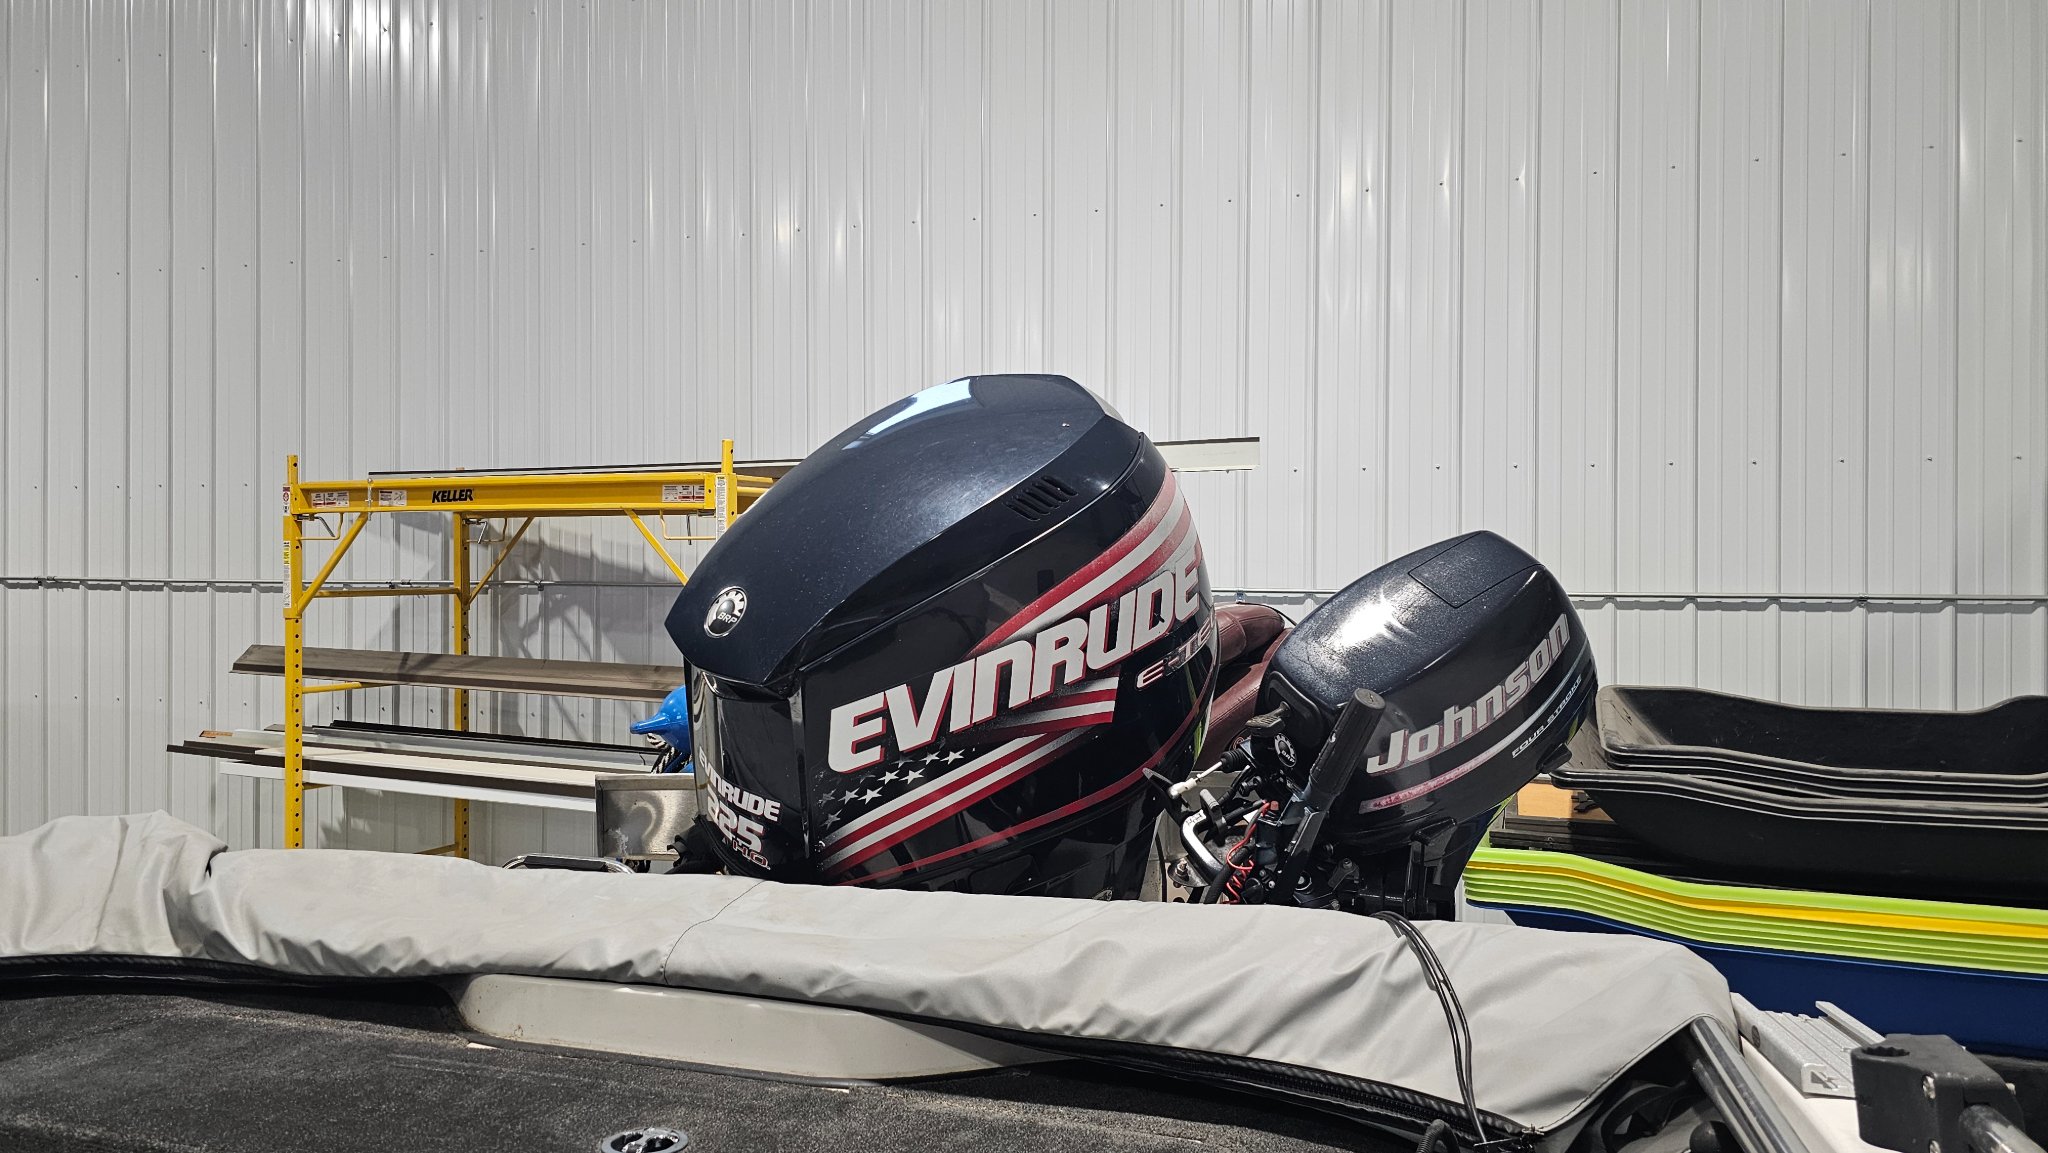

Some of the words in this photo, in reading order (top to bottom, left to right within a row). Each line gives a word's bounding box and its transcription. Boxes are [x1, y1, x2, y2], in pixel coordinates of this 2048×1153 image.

[432, 488, 474, 503] KELLER
[717, 611, 738, 624] BRP
[827, 548, 1200, 773] EVINRUDE
[1366, 613, 1571, 776] Johnson
[1511, 725, 1545, 758] FOUR
[699, 746, 781, 822] EVINRUDE
[707, 783, 764, 853] 225
